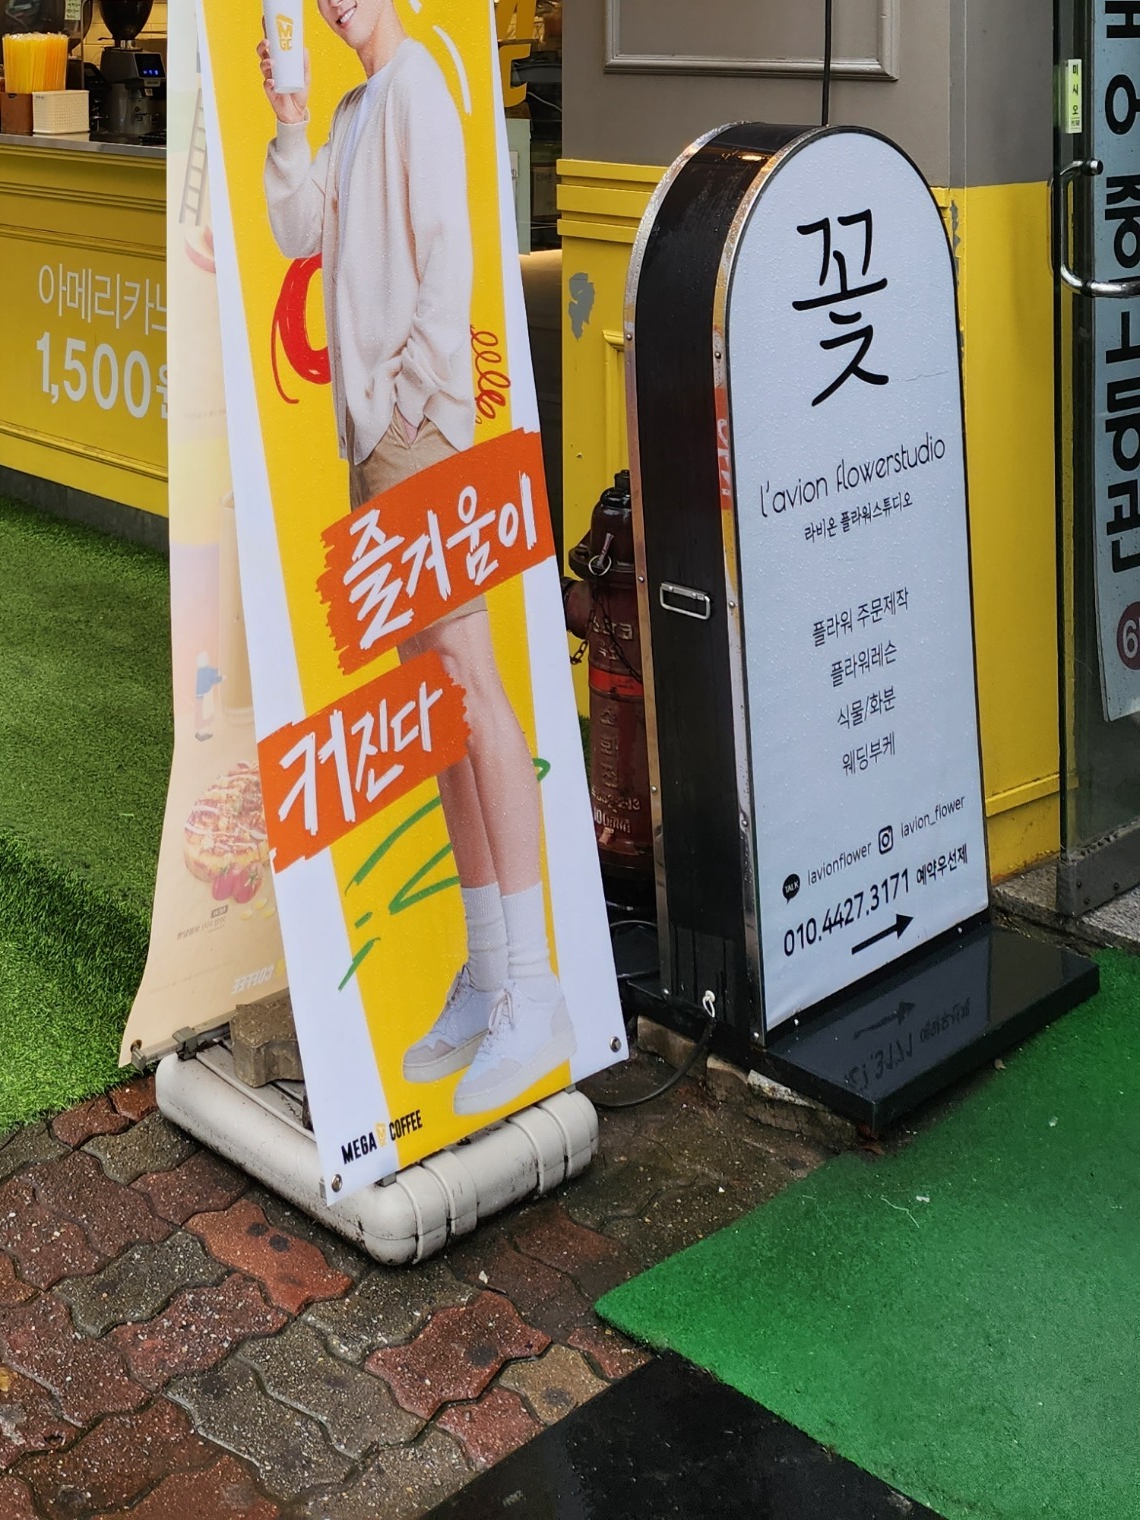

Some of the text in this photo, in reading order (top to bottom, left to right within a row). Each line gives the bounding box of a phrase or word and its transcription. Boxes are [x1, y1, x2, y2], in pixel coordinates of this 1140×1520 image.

[791, 207, 890, 408] 꽃
[759, 431, 946, 518] l'avion flowerstudio
[803, 491, 914, 543] 라비온 플라워스튜디오
[344, 472, 540, 651] 즐거움이
[811, 585, 910, 648] 플라워 주문제작
[829, 641, 899, 690] 플라워레슨
[836, 686, 898, 730] 식물/화분
[278, 679, 444, 838] 커진다
[840, 730, 897, 777] 웨딩부케
[806, 839, 873, 887] lavionflower
[900, 793, 966, 839] lavion_flower
[783, 843, 970, 958] 010.4427.3171 예약우선제
[341, 1108, 424, 1166] MEGA COFFEE
